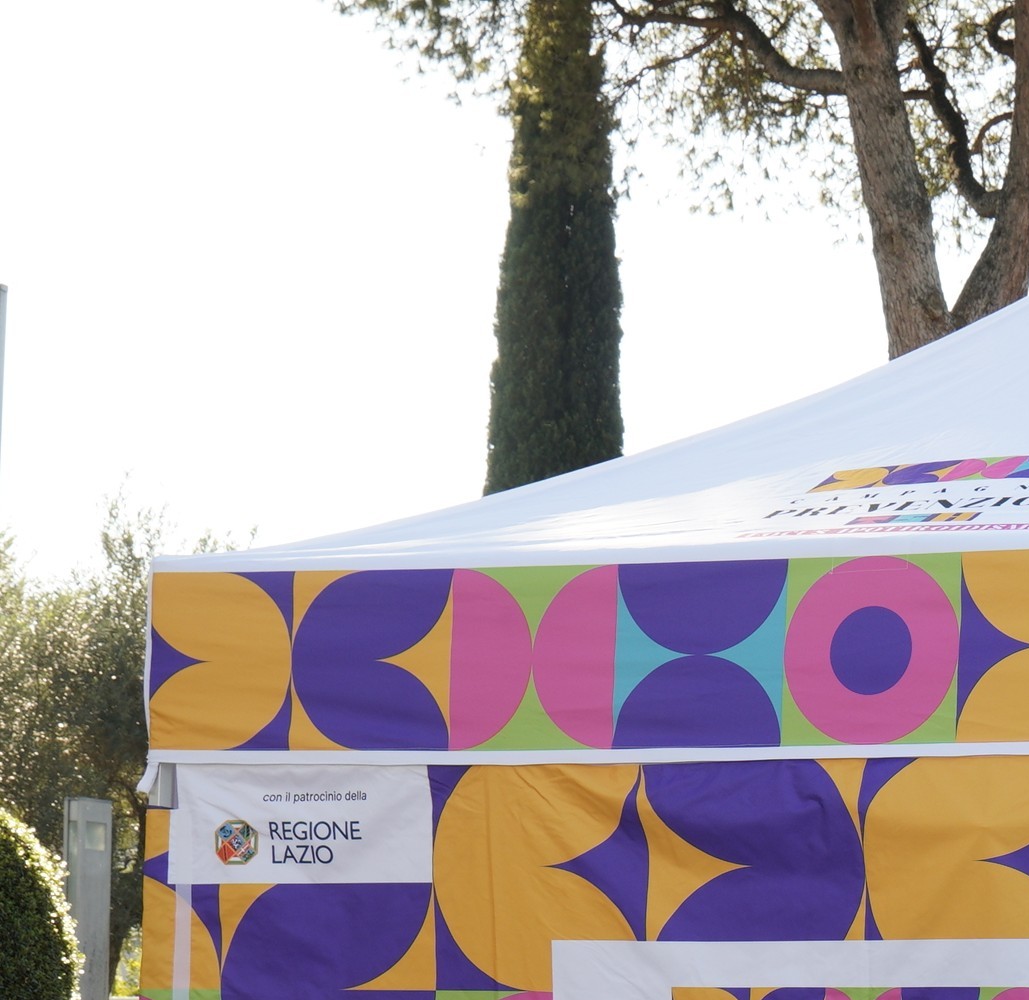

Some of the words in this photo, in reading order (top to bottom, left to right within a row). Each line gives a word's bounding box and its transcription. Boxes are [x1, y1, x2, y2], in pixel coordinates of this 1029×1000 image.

[262, 792, 282, 802] con
[285, 792, 291, 802] il
[293, 790, 342, 804] patrocinio
[345, 790, 367, 801] della
[268, 821, 362, 841] REGIONE
[271, 845, 334, 864] LAZIO
